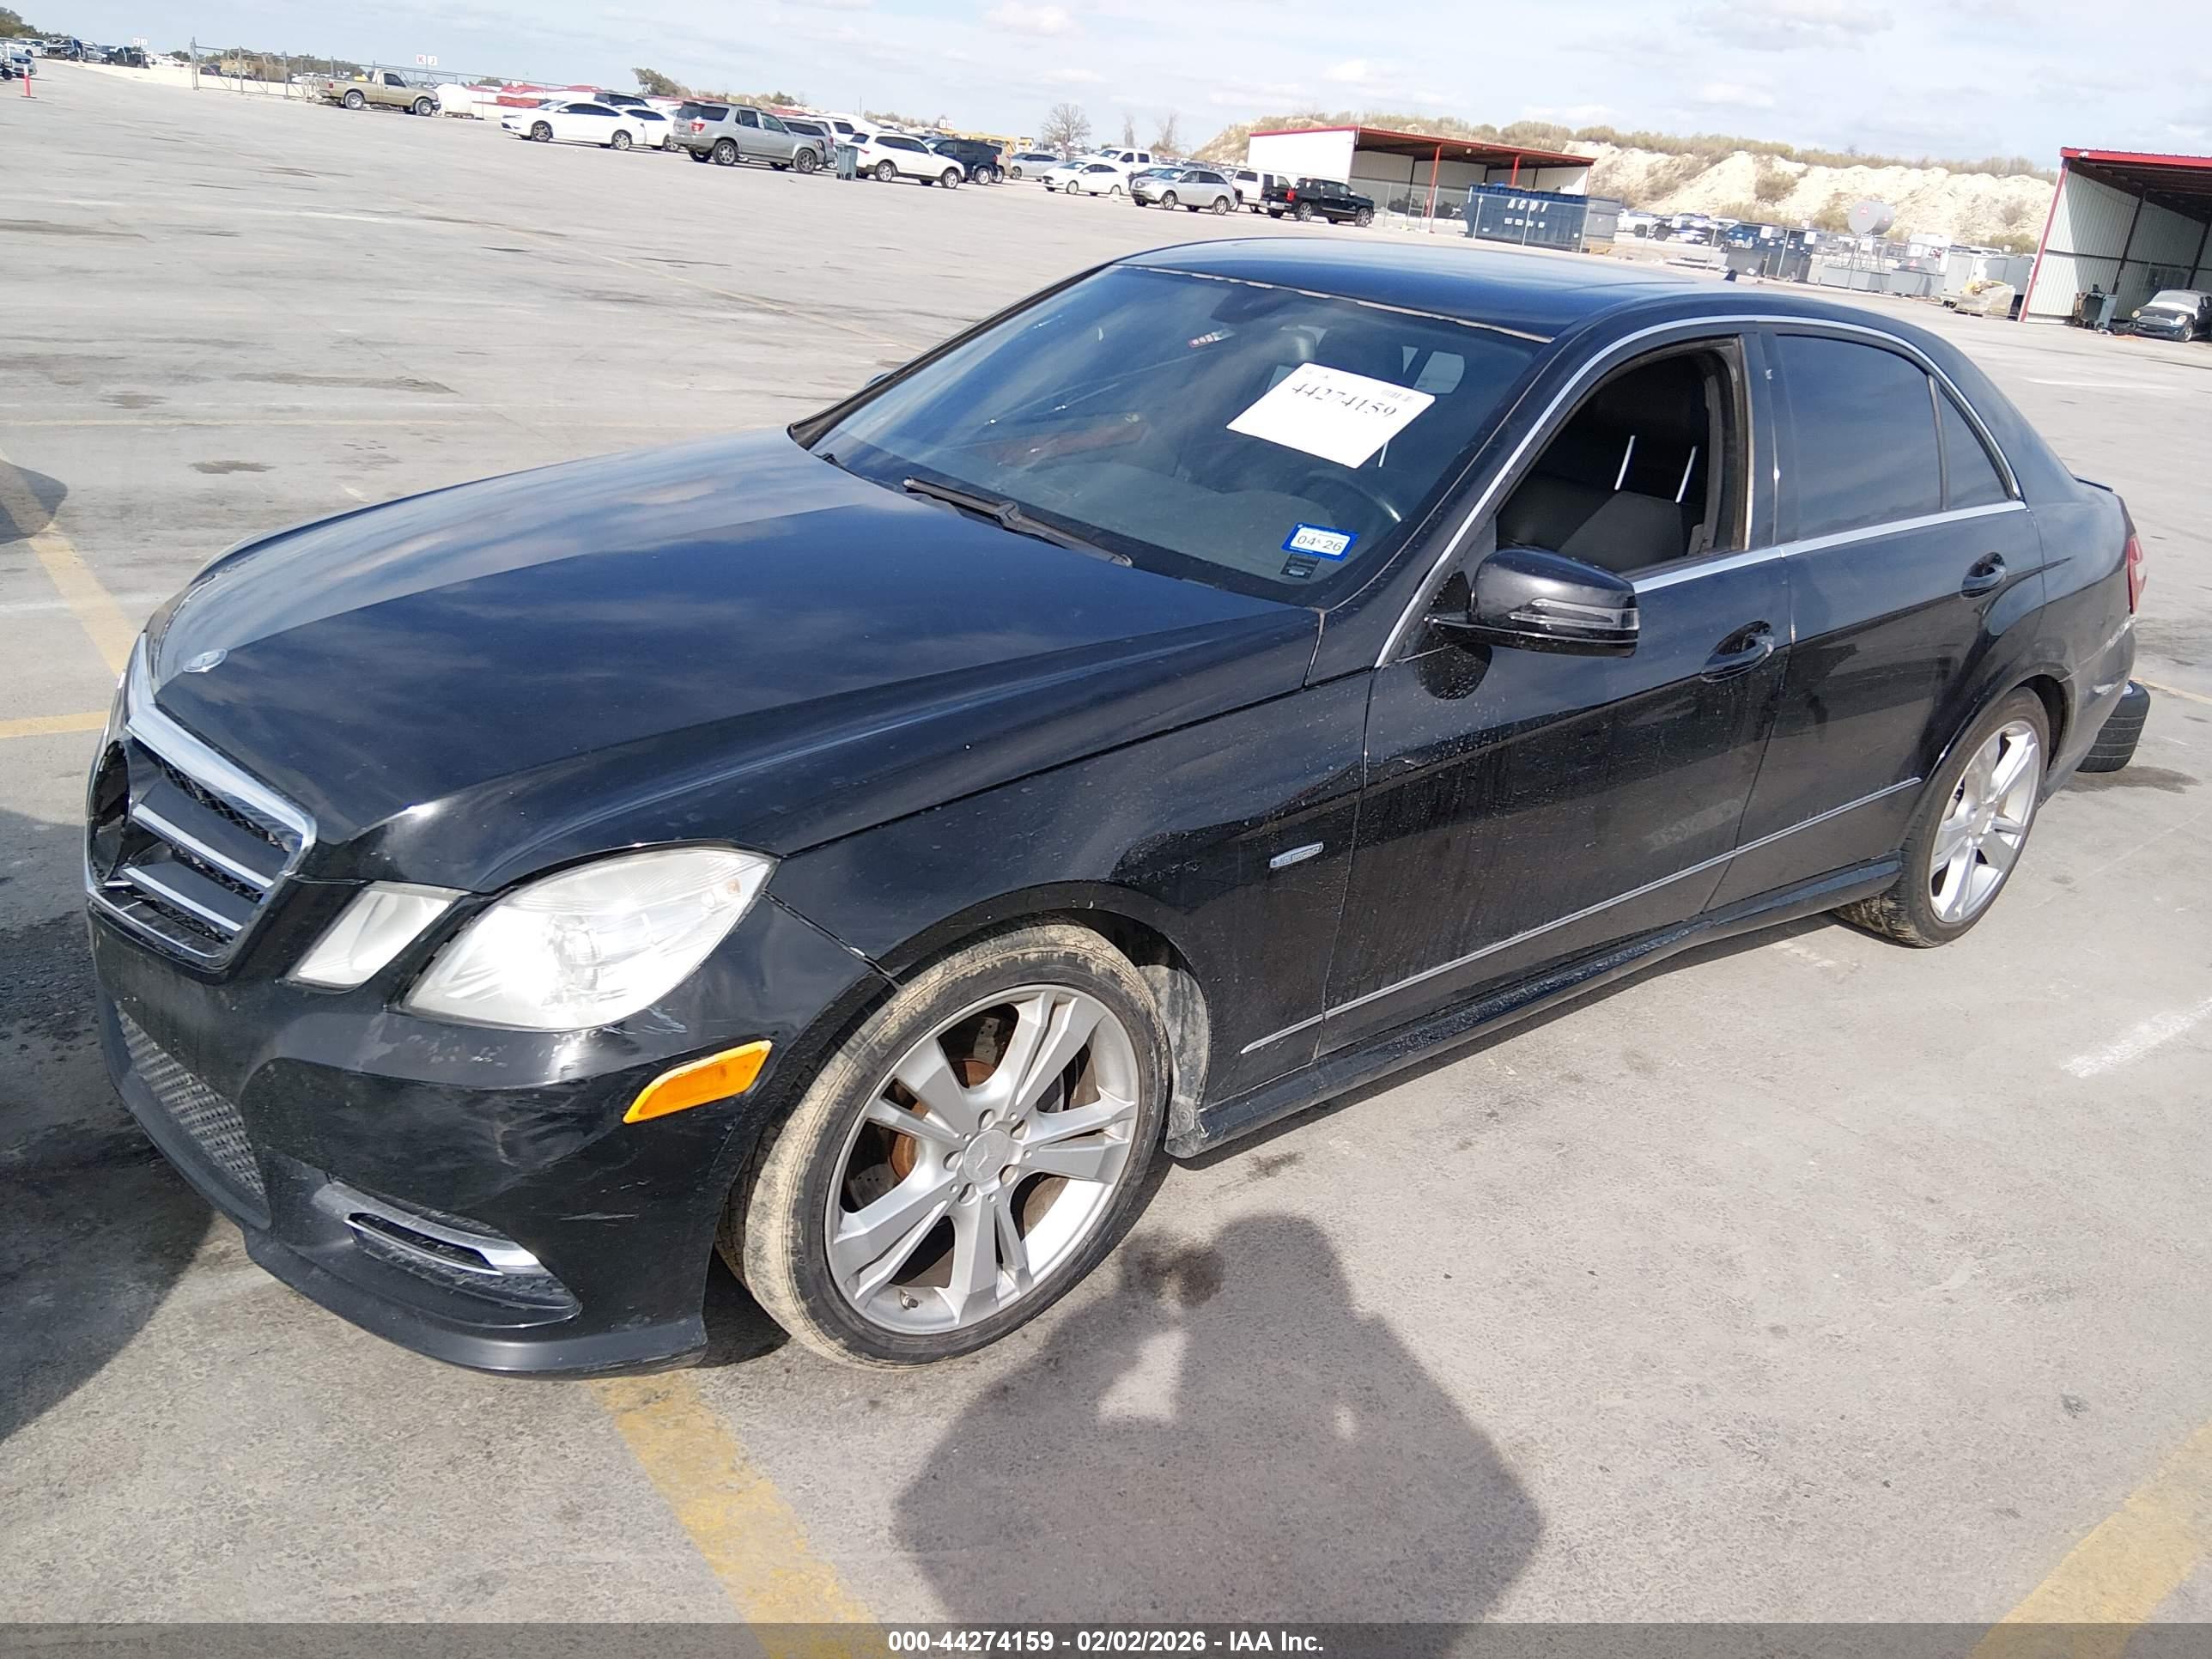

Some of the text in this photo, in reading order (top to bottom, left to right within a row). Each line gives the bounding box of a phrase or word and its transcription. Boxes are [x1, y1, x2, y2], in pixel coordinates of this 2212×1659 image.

[1291, 383, 1398, 417] 44274159
[1297, 535, 1343, 551] 04 26
